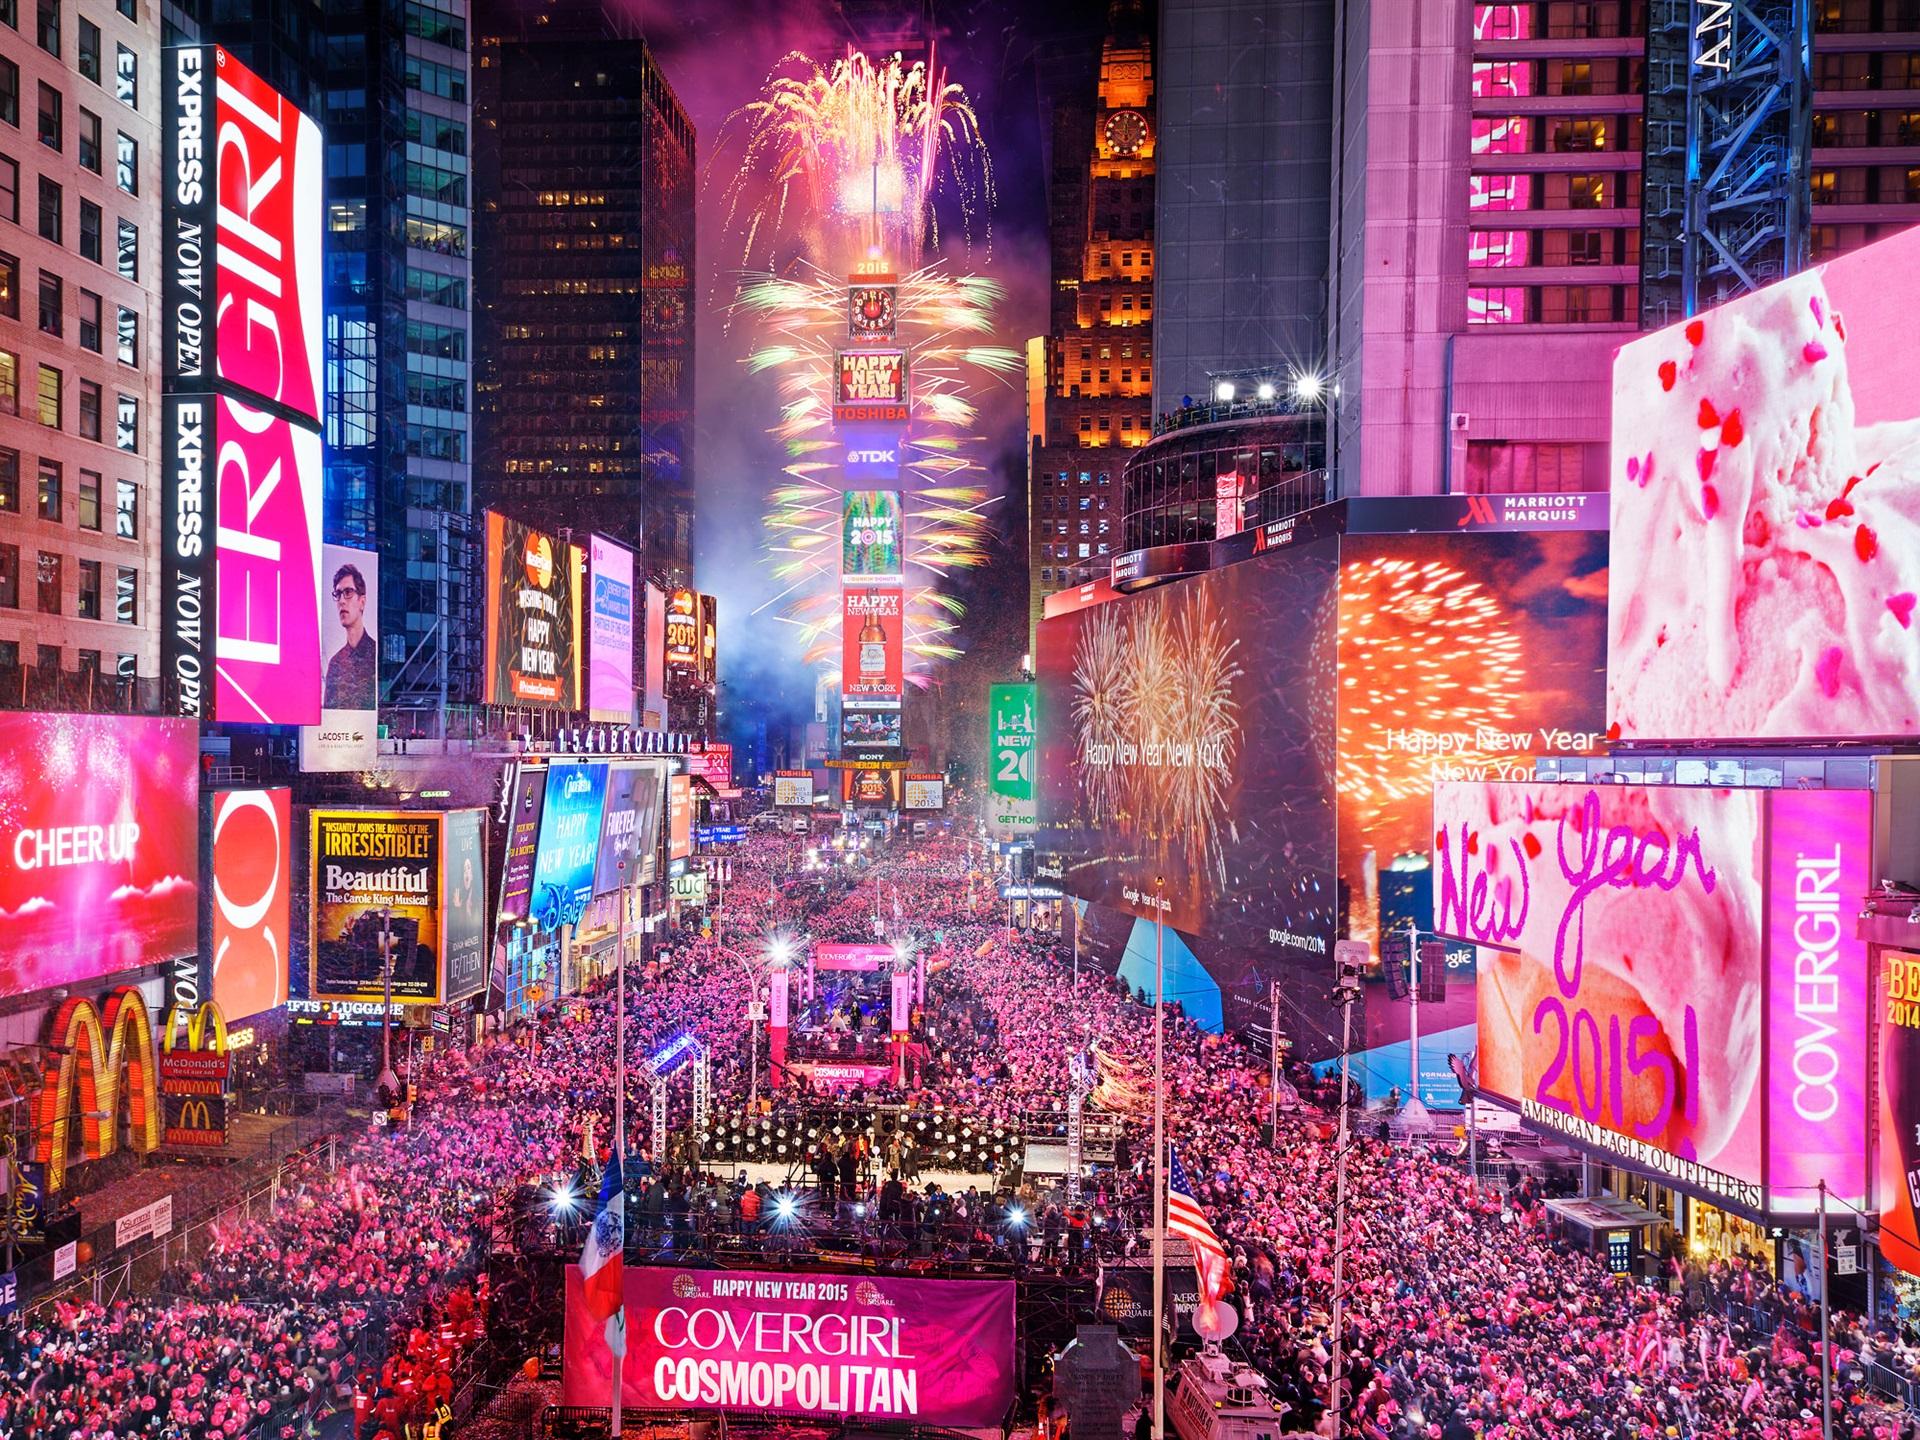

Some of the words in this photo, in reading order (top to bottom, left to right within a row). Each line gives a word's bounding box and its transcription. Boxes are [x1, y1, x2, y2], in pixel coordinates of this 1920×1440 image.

[177, 48, 203, 206] EXPRESS
[177, 218, 202, 300] NOW
[857, 262, 889, 274] 2015
[843, 355, 902, 370] HAPPY
[852, 370, 892, 385] NEW
[846, 384, 896, 399] YEAR!
[835, 407, 909, 421] TOSHIBA
[859, 451, 895, 462] TDK
[177, 403, 203, 558] EXPRESS
[1505, 496, 1587, 508] MARRIOTT
[853, 517, 892, 527] HAPPY
[1505, 509, 1578, 522] MARQUIS
[1267, 518, 1295, 535] MARRIOTT
[851, 530, 894, 545] 2015
[1267, 531, 1292, 547] MARQUIS
[519, 590, 542, 609] WISHING
[847, 595, 898, 607] HAPPY
[177, 570, 202, 652] NOW
[847, 607, 869, 615] NEW
[871, 607, 899, 615] YEAR
[528, 617, 549, 645] HAPPY
[667, 624, 695, 646] 2015
[522, 647, 538, 671] NEW
[538, 650, 555, 675] YEAR
[849, 684, 870, 692] NEW
[872, 684, 896, 692] YORK
[318, 733, 350, 741] LACOSTE
[610, 730, 692, 753] BROADWAY
[997, 735, 1031, 746] NEW
[1387, 728, 1468, 756] Happy
[1476, 728, 1532, 750] New
[1539, 728, 1599, 750] Year
[1085, 738, 1116, 770] Happy
[1116, 738, 1138, 765] New
[1139, 737, 1163, 766] Year
[1167, 737, 1194, 767] New
[1195, 734, 1225, 768] York
[1431, 762, 1487, 781] New
[862, 783, 883, 793] 2015
[784, 796, 806, 804] 2015
[356, 823, 374, 833] JOINS
[375, 823, 386, 833] THE
[387, 823, 407, 834] RANKS
[408, 824, 417, 834] OF
[417, 824, 429, 834] THE
[556, 813, 588, 840] HAPPY
[998, 815, 1018, 824] GET
[14, 824, 104, 870] CHEER
[109, 823, 140, 861] UP
[538, 850, 565, 876] NEW
[569, 842, 596, 869] YEAR!
[326, 864, 428, 893] Beautiful
[326, 892, 342, 903] The
[344, 892, 372, 904] Carole
[373, 893, 394, 907] King
[394, 895, 428, 906] Musical
[1122, 885, 1139, 905] Google
[1141, 891, 1151, 904] Year
[1269, 928, 1326, 955] google.com/2014
[451, 950, 480, 980] IF/THEN
[1792, 842, 1842, 1122] COVERGIRL
[1887, 1000, 1920, 1029] 2014
[163, 1058, 225, 1069] McDonald's
[814, 1067, 865, 1079] COSMOPOLITAN
[1522, 1100, 1594, 1143] AMERICAN
[1599, 1126, 1646, 1164] EAGLE
[1650, 1148, 1760, 1209] OUTFITTERS
[713, 1279, 753, 1298] HAPPY
[754, 1281, 784, 1299] NEW
[785, 1281, 816, 1300] YEAR
[818, 1283, 848, 1301] 2015
[1120, 1309, 1153, 1318] SQUARE
[653, 1306, 915, 1359] COVERGIRL
[653, 1356, 918, 1415] COSMOPOLITAN
